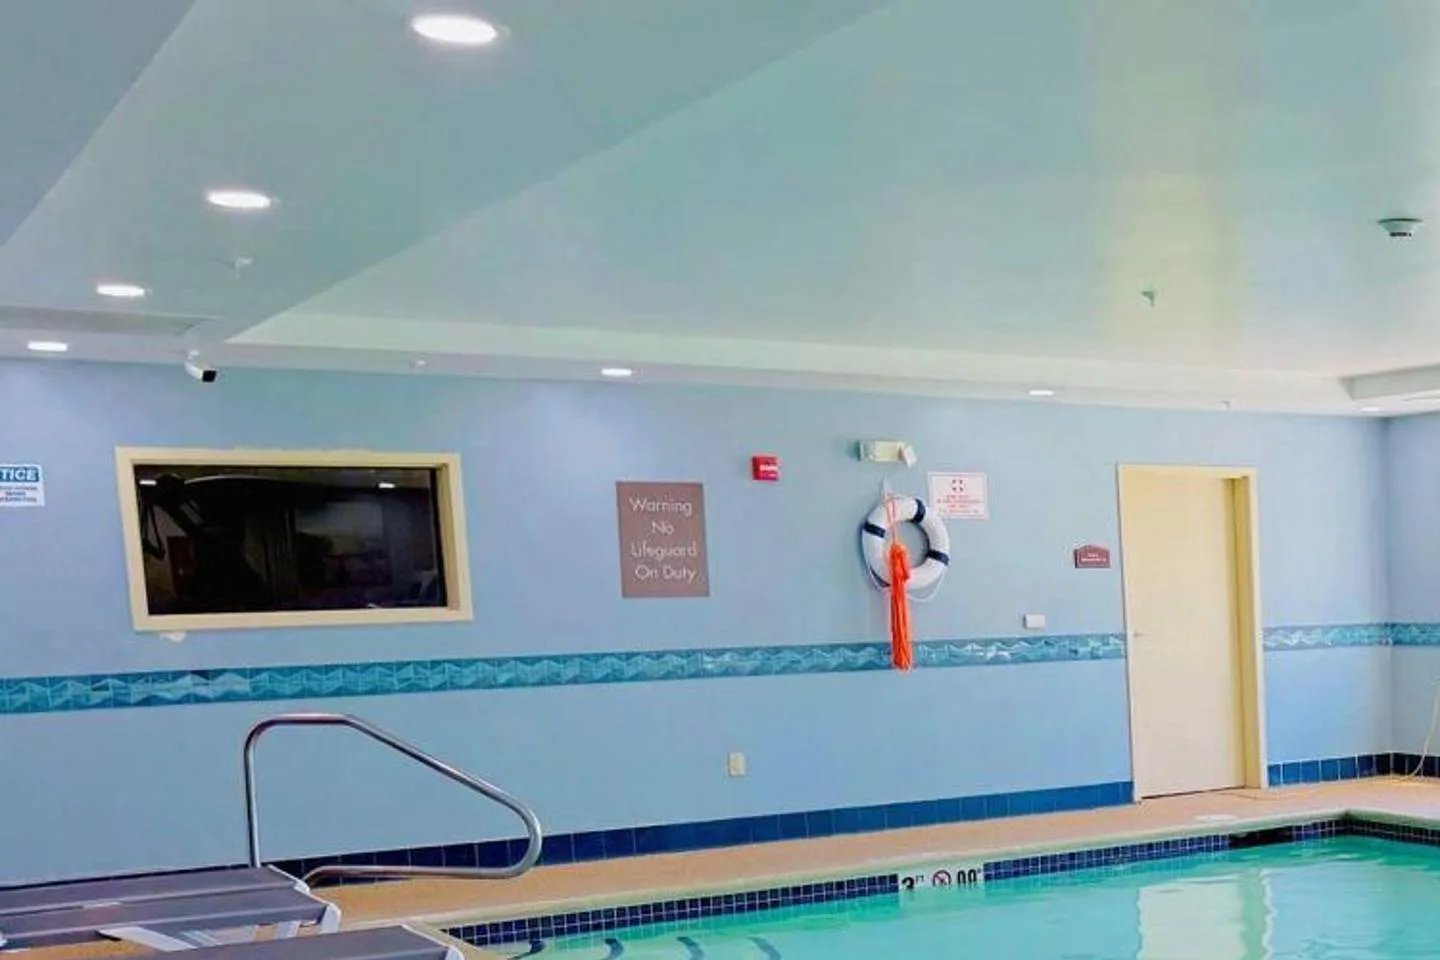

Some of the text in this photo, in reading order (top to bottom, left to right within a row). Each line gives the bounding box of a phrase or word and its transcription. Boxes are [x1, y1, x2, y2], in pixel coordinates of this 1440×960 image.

[629, 497, 692, 518] Warning
[651, 520, 675, 535] No
[631, 540, 697, 561] Lifeguard
[635, 564, 698, 584] On Duty
